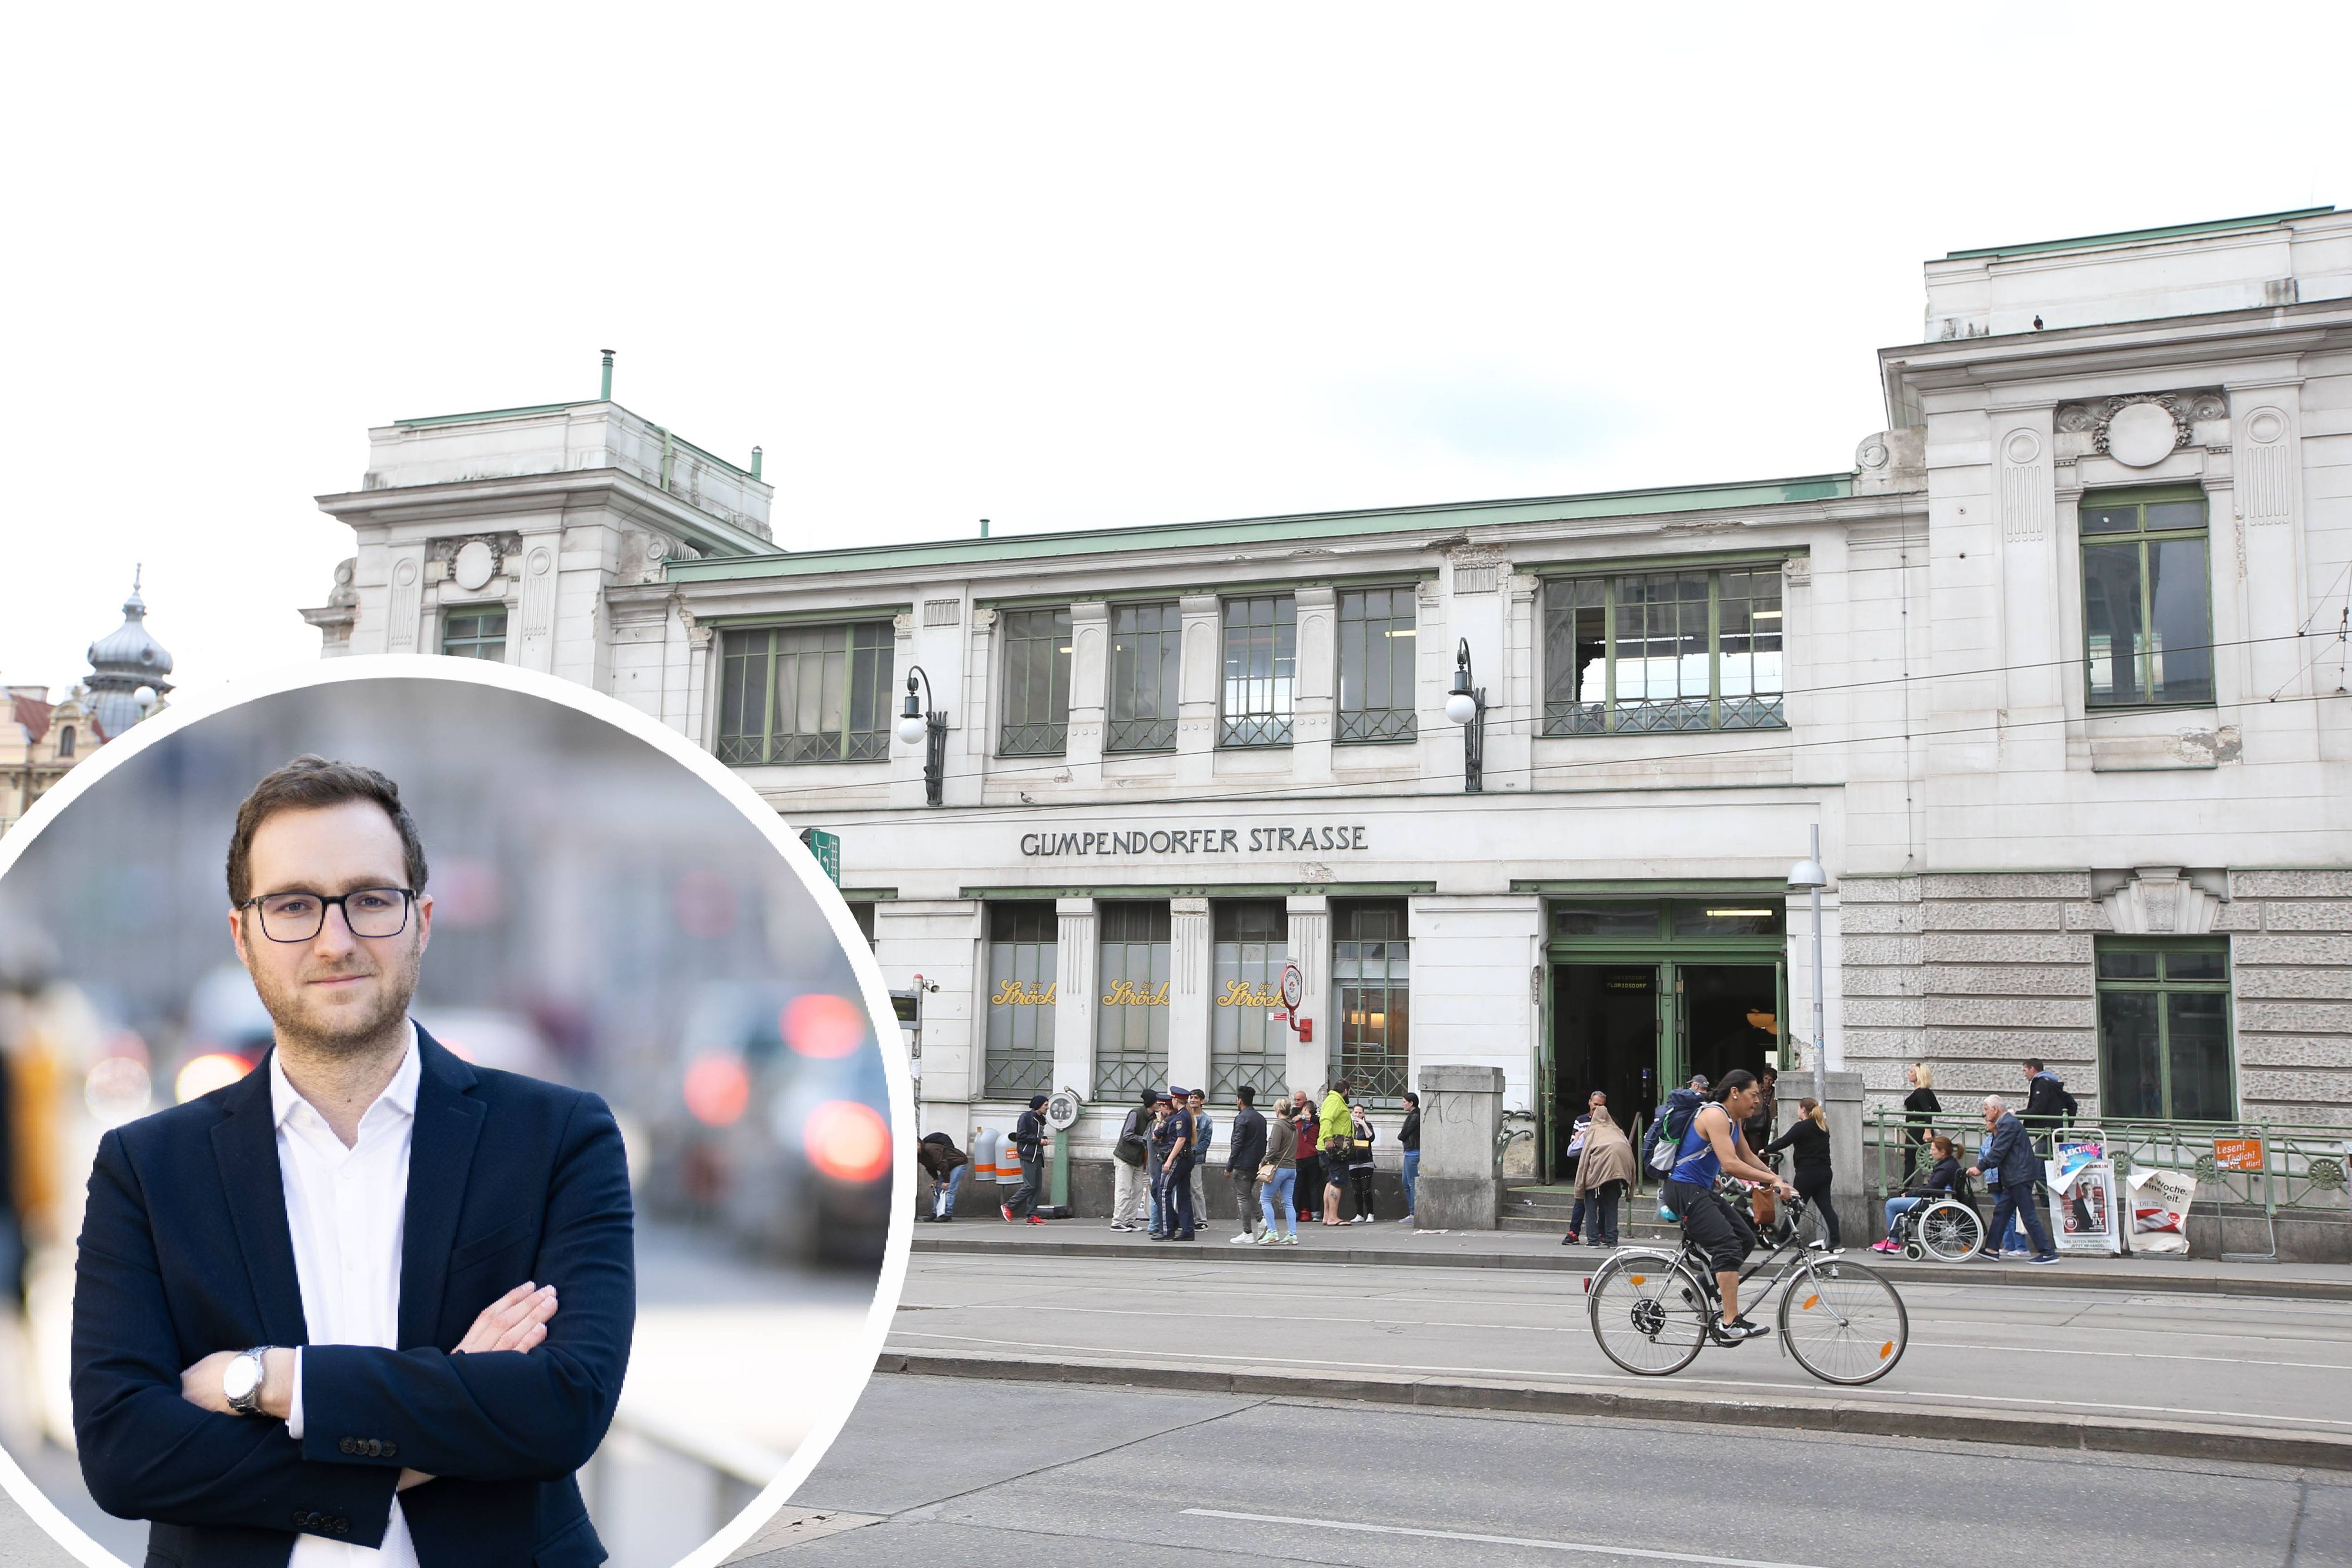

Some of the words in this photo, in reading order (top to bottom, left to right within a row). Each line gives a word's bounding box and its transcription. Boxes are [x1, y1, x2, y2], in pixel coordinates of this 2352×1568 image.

[1020, 830, 1238, 855] GUMPENDORFER
[1249, 826, 1368, 851] STRASSE
[991, 979, 1057, 1006] Ströck
[1101, 979, 1170, 1006] Ströck
[1217, 979, 1286, 1008] Ströck
[2217, 1141, 2245, 1154] Lesen!
[2246, 1159, 2260, 1168] Hier!
[2143, 1182, 2161, 1193] eine
[2156, 1178, 2187, 1195] Woche.
